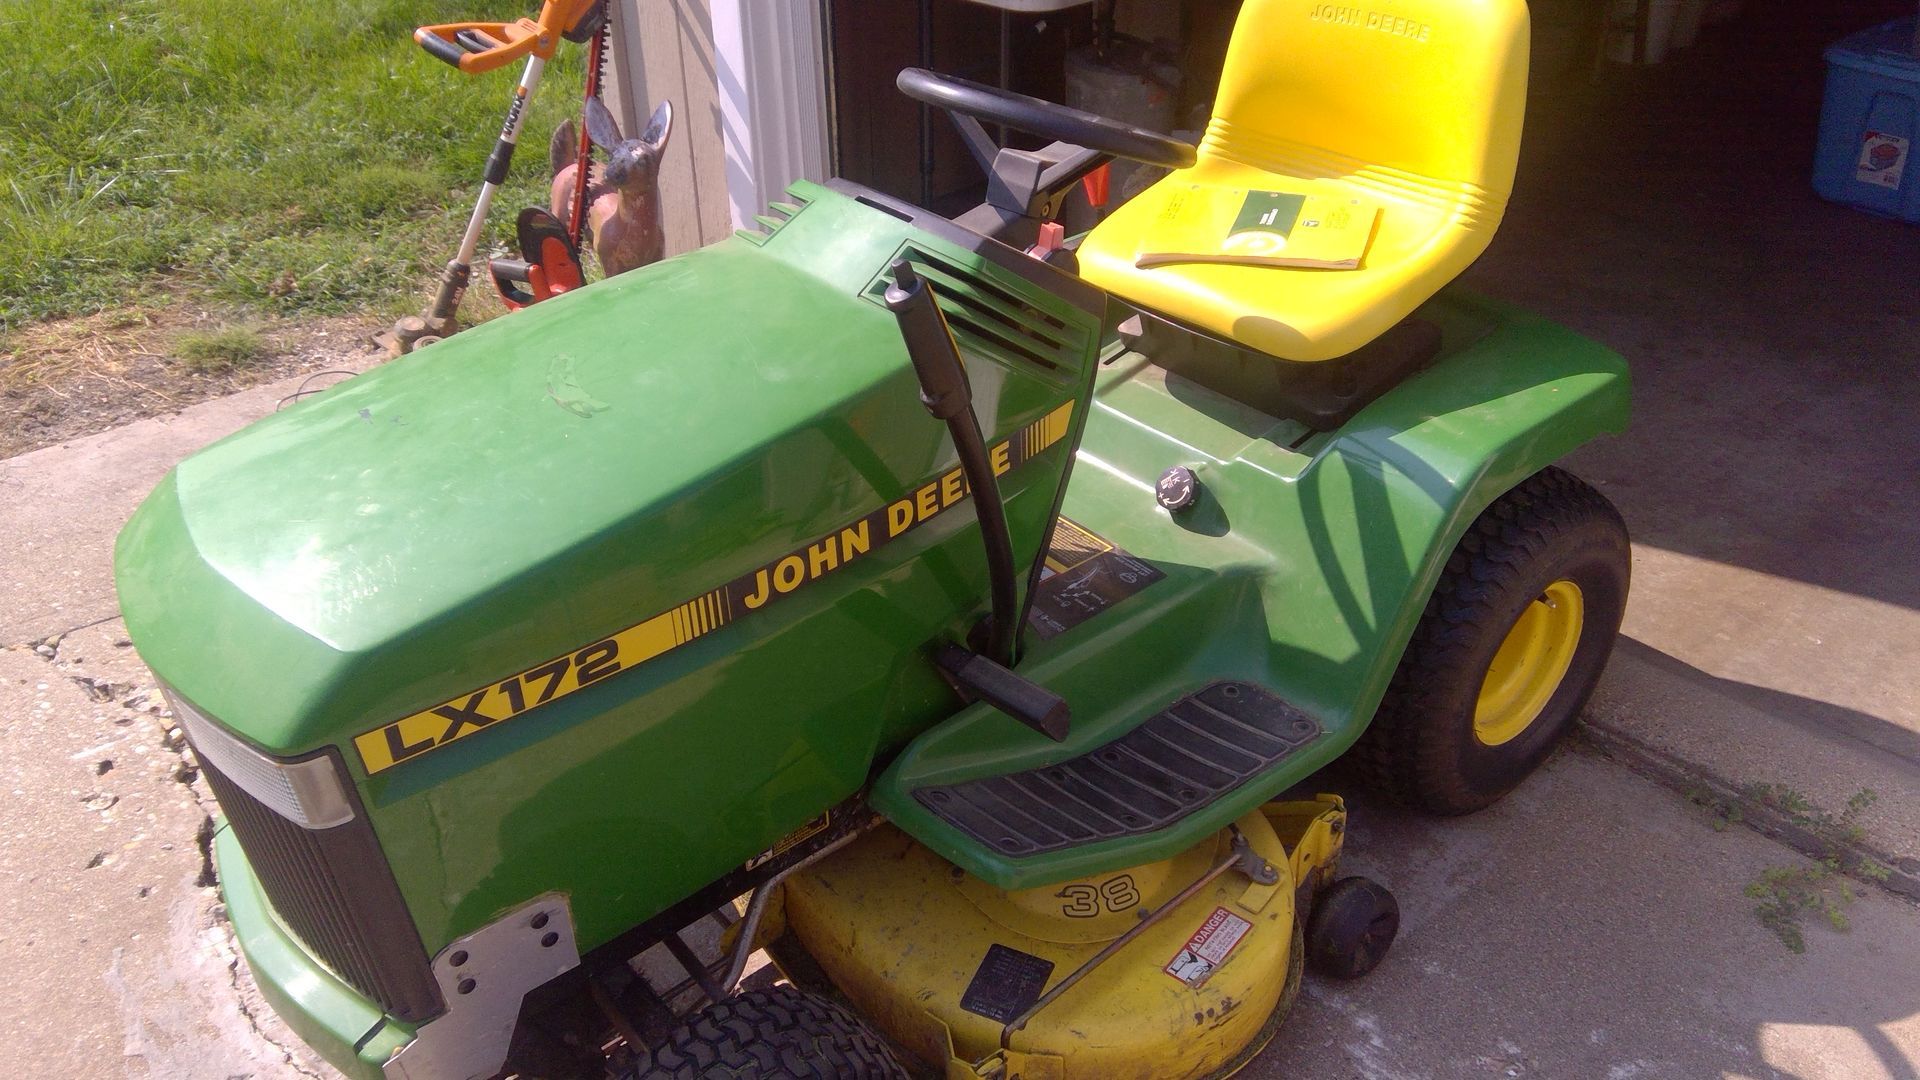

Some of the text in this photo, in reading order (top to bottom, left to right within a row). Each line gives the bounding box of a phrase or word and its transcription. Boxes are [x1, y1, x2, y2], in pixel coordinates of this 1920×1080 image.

[1310, 4, 1431, 41] JOHN DEERE
[744, 440, 1011, 609] JOHN DEEE
[383, 639, 621, 763] LX172
[1061, 874, 1141, 918] 38
[1196, 908, 1229, 944] DANGER
